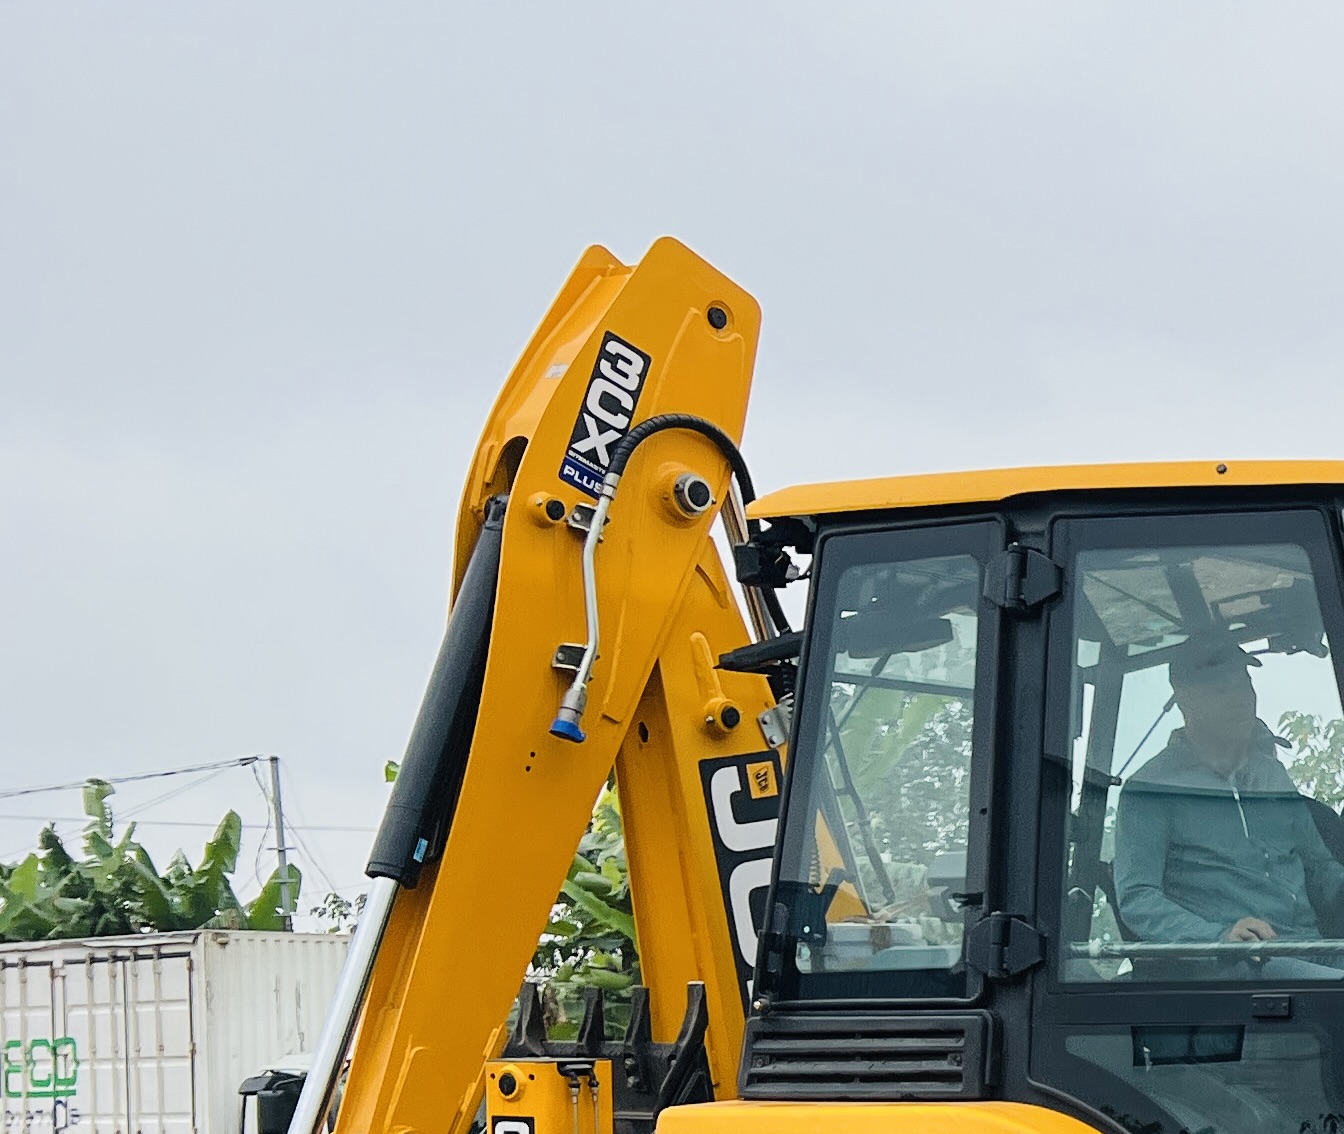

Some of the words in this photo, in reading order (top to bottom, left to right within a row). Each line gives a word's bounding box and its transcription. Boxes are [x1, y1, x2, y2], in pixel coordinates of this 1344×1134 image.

[571, 340, 645, 468] 3CX
[563, 464, 604, 494] PLUS
[711, 765, 779, 968] JC
